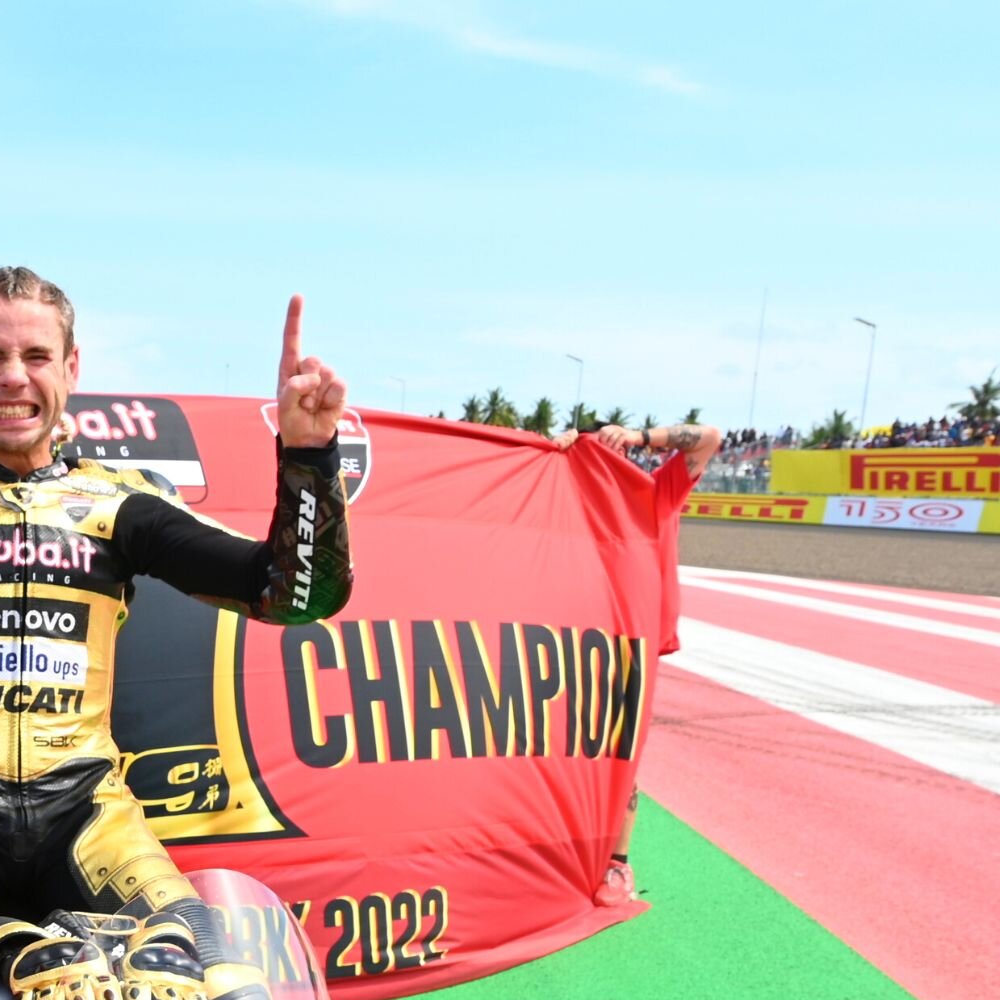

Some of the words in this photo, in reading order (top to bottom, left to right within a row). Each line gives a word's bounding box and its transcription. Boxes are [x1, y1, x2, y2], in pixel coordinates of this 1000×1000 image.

[850, 452, 1000, 493] PIRELLI
[681, 495, 808, 519] ELLI
[840, 500, 963, 523] 150
[292, 488, 316, 610] REV'IT!
[53, 660, 80, 680] ups
[281, 618, 646, 768] CHAMPION
[33, 736, 77, 748] SBK
[323, 885, 449, 979] 2022
